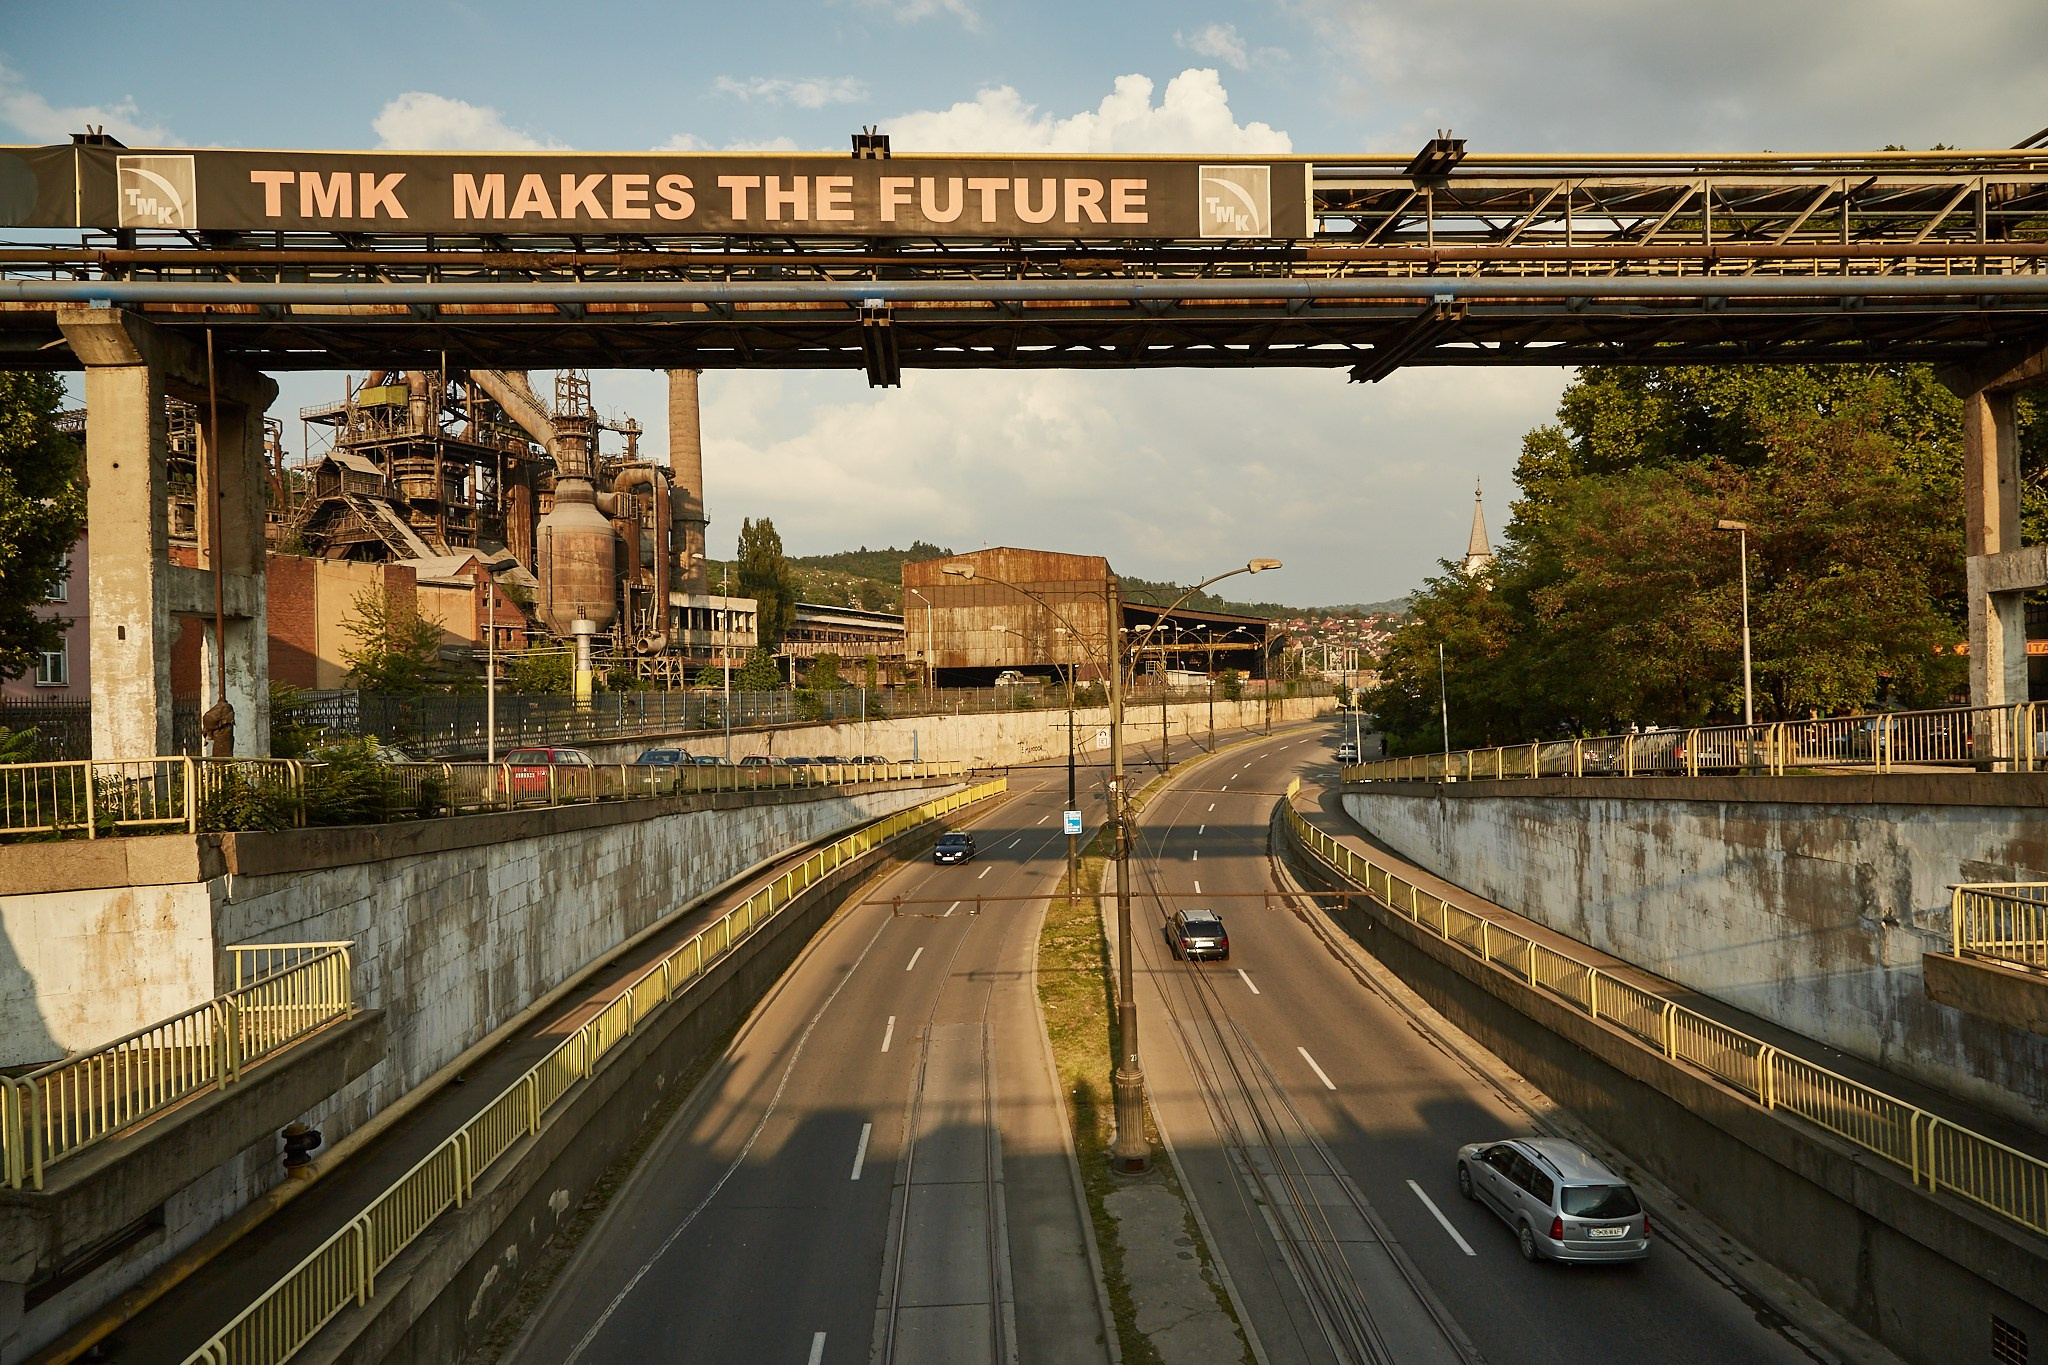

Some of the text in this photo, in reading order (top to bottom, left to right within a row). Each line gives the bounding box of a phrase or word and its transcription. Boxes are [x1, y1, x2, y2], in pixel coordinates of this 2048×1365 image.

[125, 188, 174, 225] TMK
[250, 170, 1149, 224] TMK MAKES THE FUTURE
[1205, 197, 1250, 232] TMK
